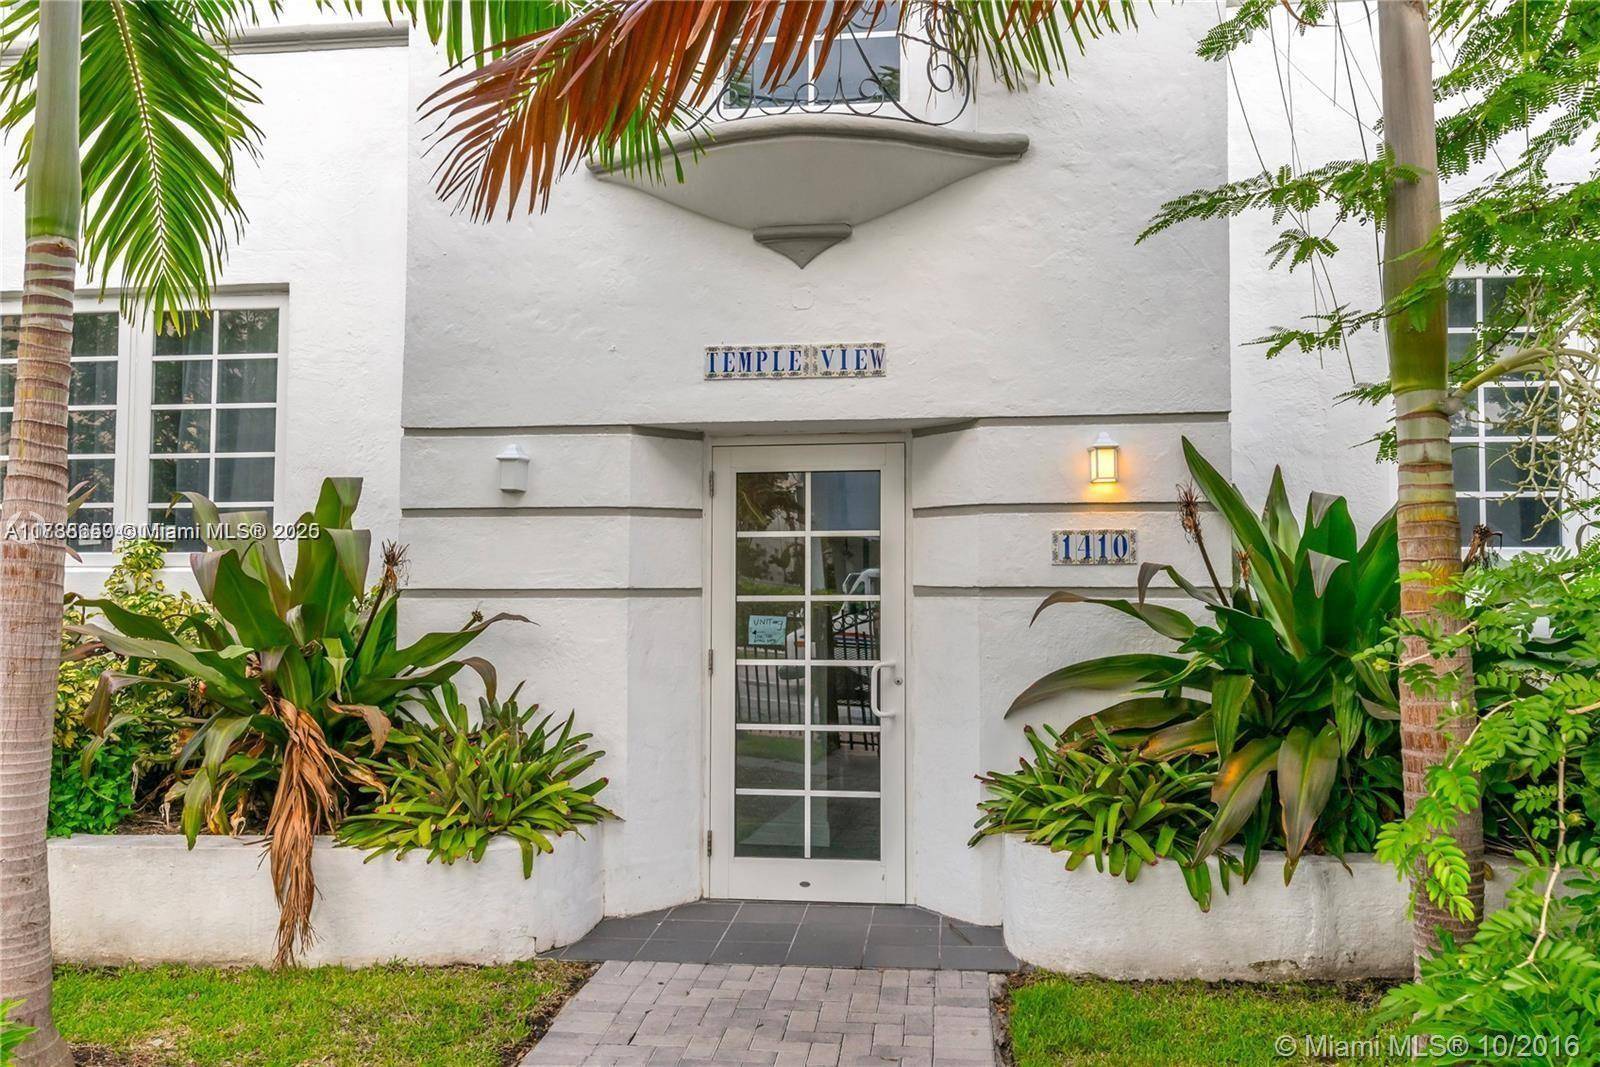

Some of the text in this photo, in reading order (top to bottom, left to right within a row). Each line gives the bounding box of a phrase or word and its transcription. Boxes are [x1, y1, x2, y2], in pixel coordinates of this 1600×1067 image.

[706, 348, 886, 373] TEMPLE VIEW
[1062, 534, 1128, 560] 1410
